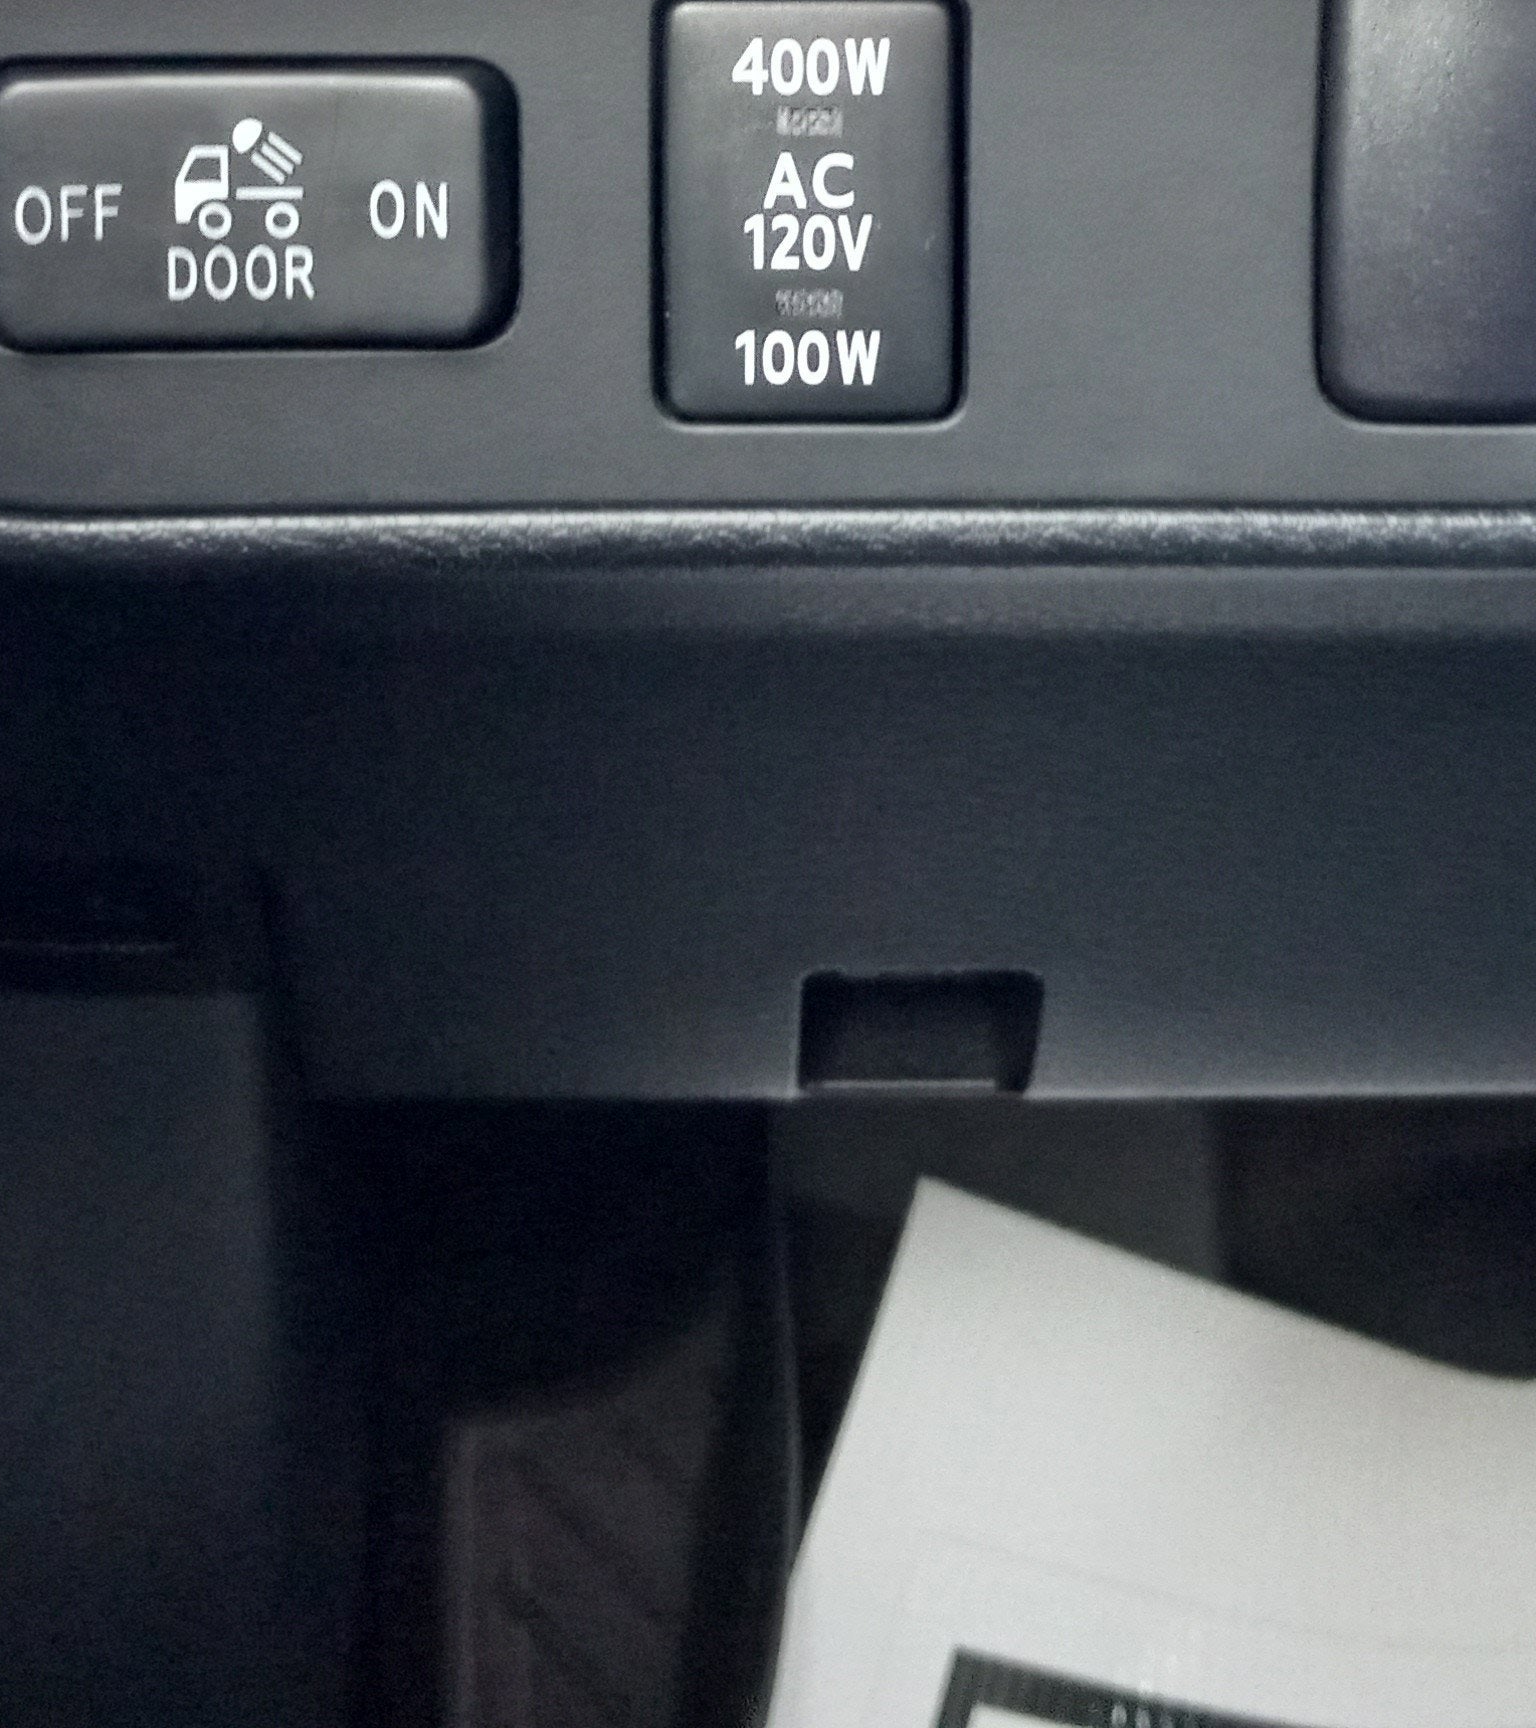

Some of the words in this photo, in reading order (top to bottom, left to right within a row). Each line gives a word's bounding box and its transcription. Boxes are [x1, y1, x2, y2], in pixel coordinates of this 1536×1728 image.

[731, 37, 892, 98] 400W
[367, 177, 449, 241] ON
[761, 151, 856, 210] AC
[13, 182, 124, 246] OFF
[742, 212, 874, 273] 120V
[166, 243, 316, 302] DOOR
[733, 328, 882, 387] 100W
